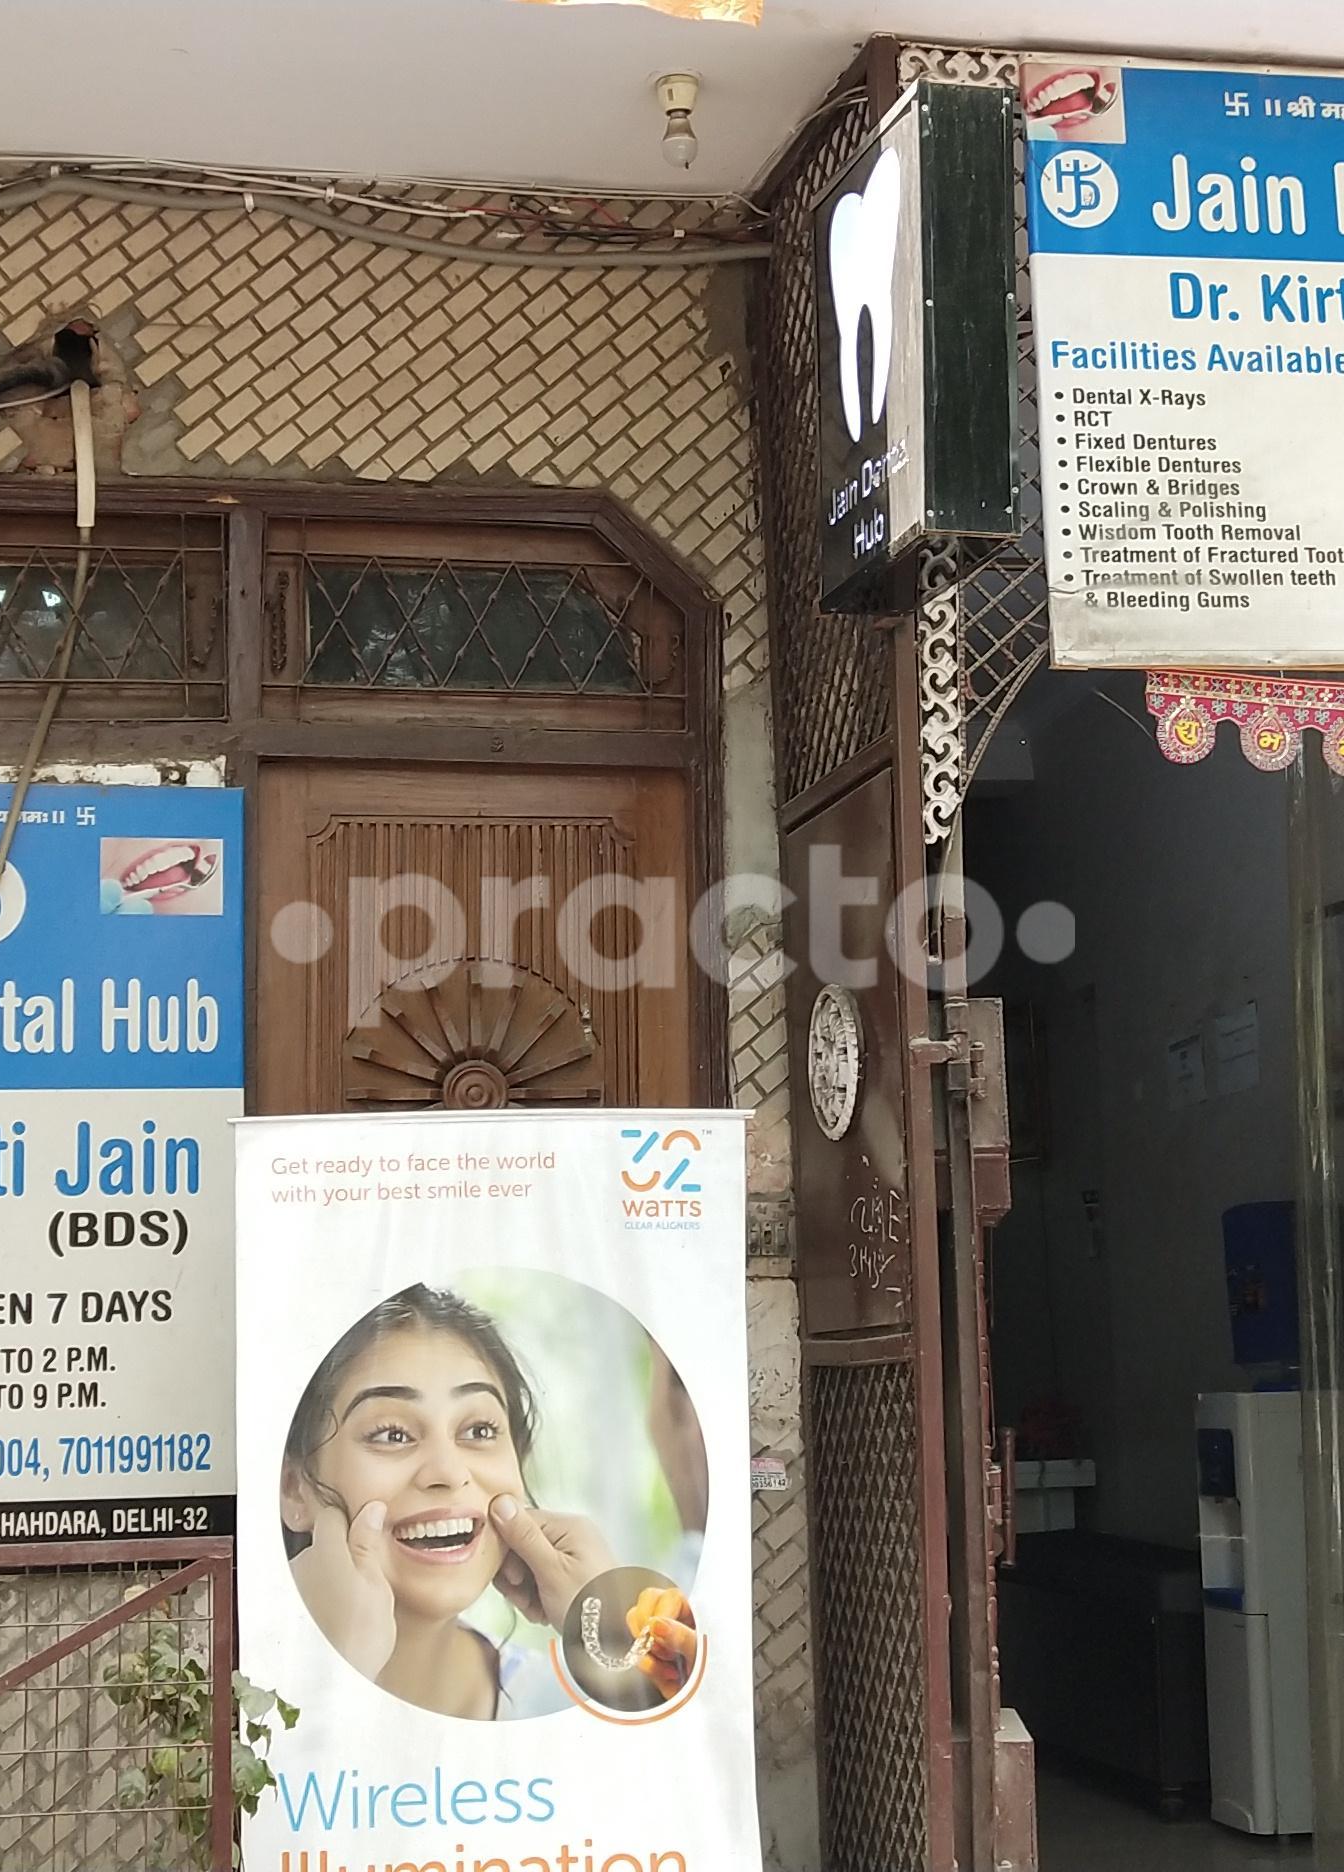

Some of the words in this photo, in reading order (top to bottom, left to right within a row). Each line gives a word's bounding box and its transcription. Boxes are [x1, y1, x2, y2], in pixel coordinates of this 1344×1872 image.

[1287, 96, 1315, 118] श्री
[1153, 155, 1306, 235] Jain
[1169, 273, 1239, 323] Dr.
[1051, 341, 1197, 370] Facilities
[1072, 389, 1132, 405] Dental
[1139, 390, 1206, 409] X-Rays
[1074, 411, 1112, 427] RCT
[1075, 434, 1125, 449] Fixed
[1133, 435, 1216, 451] Dentures
[1076, 457, 1150, 472] Flexible
[1159, 458, 1242, 473] Dentures
[828, 478, 858, 526] Jain
[1078, 480, 1137, 495] Crown
[1147, 481, 1159, 495] &
[1168, 480, 1240, 499] Bridges
[1079, 503, 1149, 521] Scaling
[1159, 503, 1171, 517] &
[1180, 503, 1266, 522] Polishing
[853, 508, 884, 560] Hub
[1079, 525, 1156, 540] Wisdom
[1163, 525, 1213, 540] Tooth
[1221, 525, 1300, 541] Removal
[1080, 548, 1176, 563] Treatment
[1184, 548, 1200, 563] of
[1208, 549, 1298, 563] Fractured
[1082, 570, 1178, 585] Treatment
[1185, 570, 1202, 584] of
[1209, 570, 1283, 586] Swollen
[1290, 570, 1336, 586] teeth
[1085, 593, 1098, 607] &
[1107, 593, 1190, 612] Bleeding
[1198, 593, 1250, 608] Gums
[101, 978, 219, 1054] Hub
[56, 1121, 199, 1197] Jain
[271, 1155, 308, 1175] Get
[316, 1155, 371, 1178] ready
[379, 1155, 401, 1173] to
[408, 1153, 450, 1173] face
[457, 1152, 489, 1171] the
[496, 1152, 555, 1171] world
[272, 1183, 316, 1205] with
[323, 1185, 368, 1206] your
[377, 1183, 420, 1200] best
[427, 1182, 478, 1199] smile
[486, 1183, 531, 1199] ever
[48, 1209, 188, 1256] (BDS)
[624, 1221, 652, 1230] CLEAR
[655, 1221, 701, 1230] ALIGNERS
[47, 1293, 67, 1323] 7
[81, 1290, 172, 1322] DAYS
[1, 1348, 32, 1373] TO
[43, 1348, 56, 1372] 2
[67, 1347, 116, 1372] P.M.
[33, 1383, 47, 1408] 9
[58, 1382, 106, 1408] P.M.
[59, 1433, 211, 1474] 7011991182
[112, 1507, 208, 1533] DELHI-32
[277, 1766, 555, 1832] Wireless
